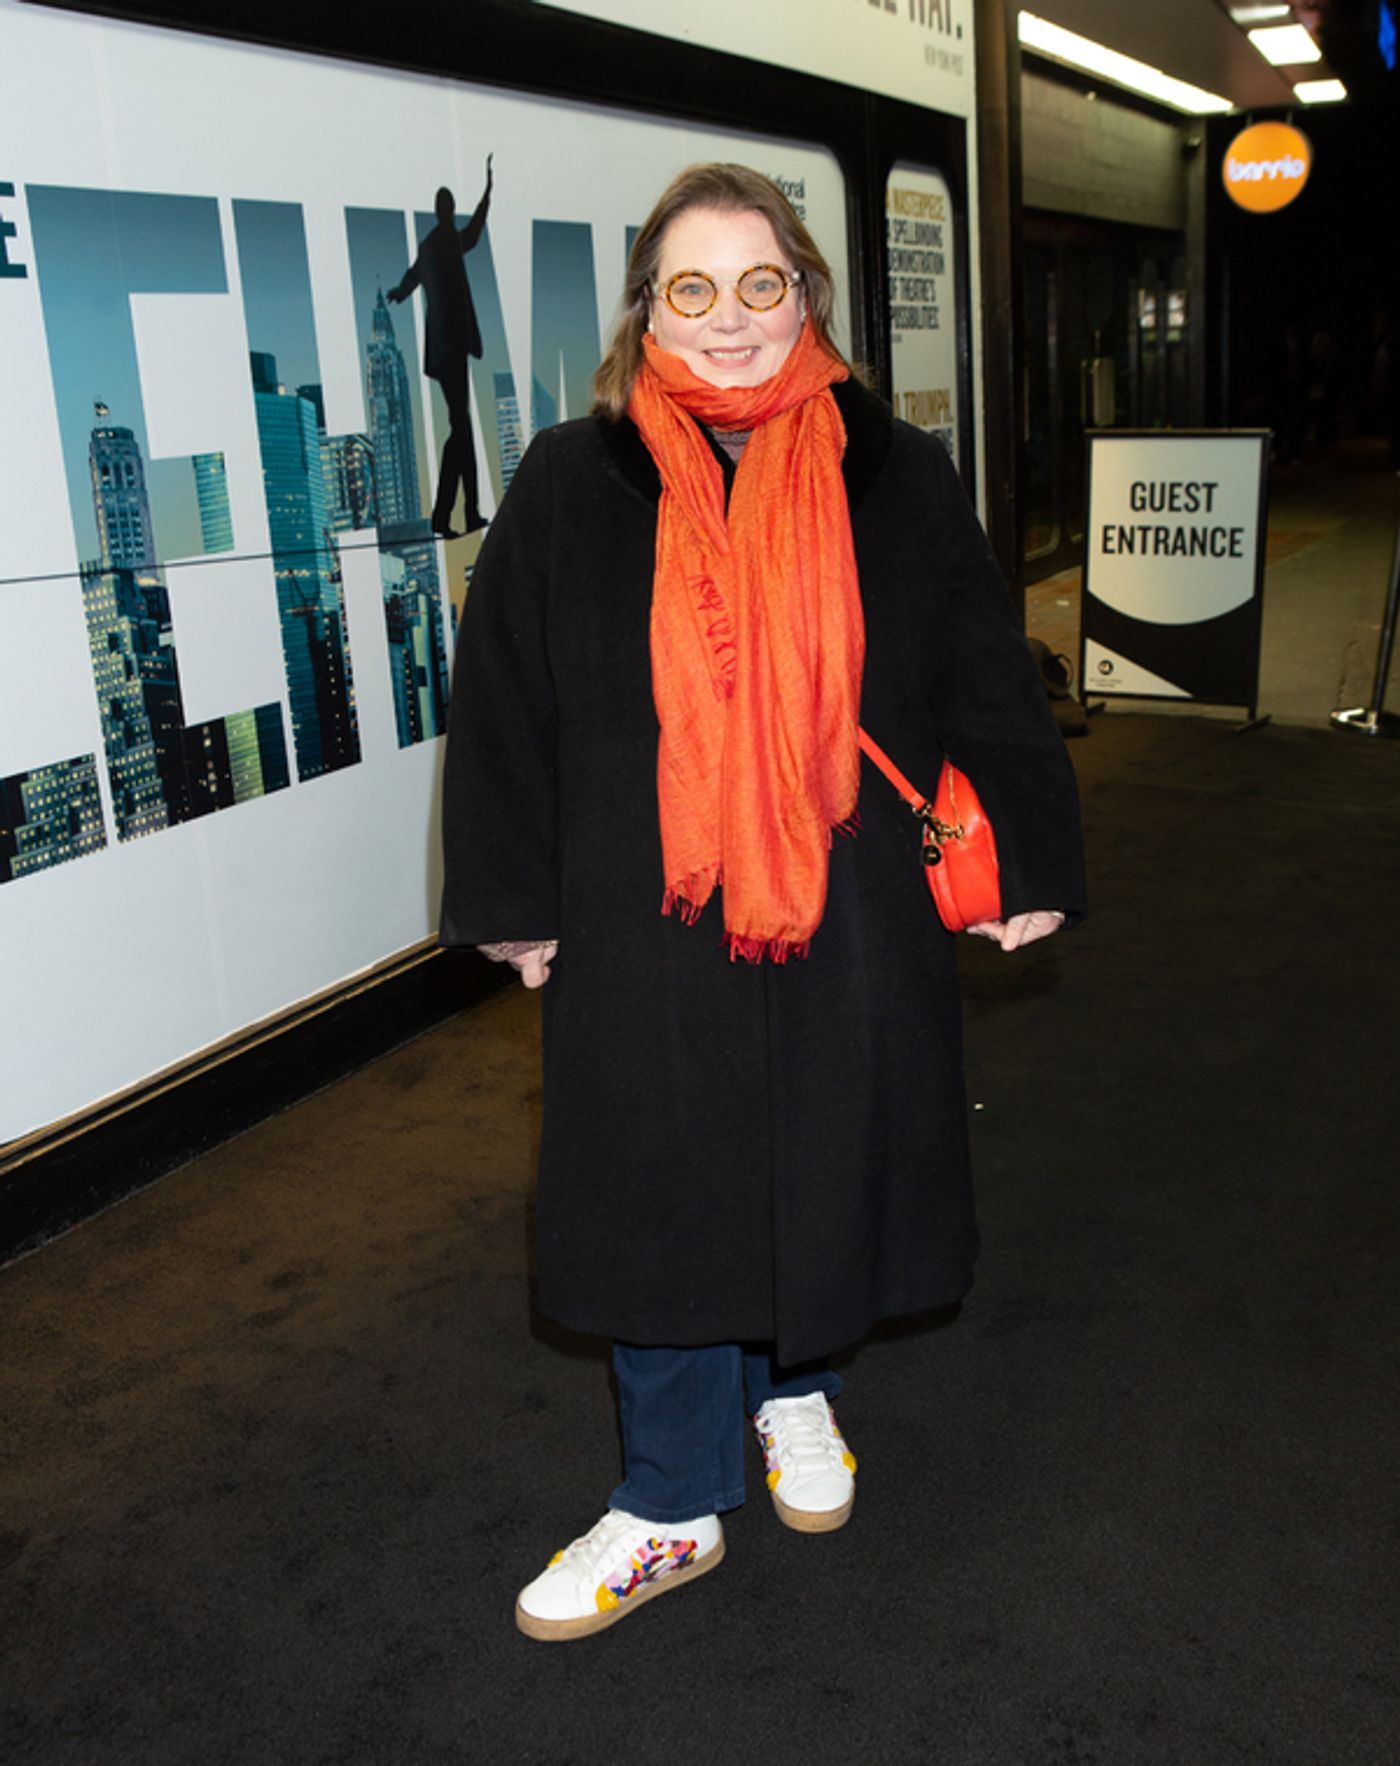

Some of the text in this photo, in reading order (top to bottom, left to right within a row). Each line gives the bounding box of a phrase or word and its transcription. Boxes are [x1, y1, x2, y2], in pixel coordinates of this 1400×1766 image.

[1228, 155, 1305, 181] barrio
[1129, 480, 1219, 513] GUEST
[1101, 524, 1245, 559] ENTRANCE
